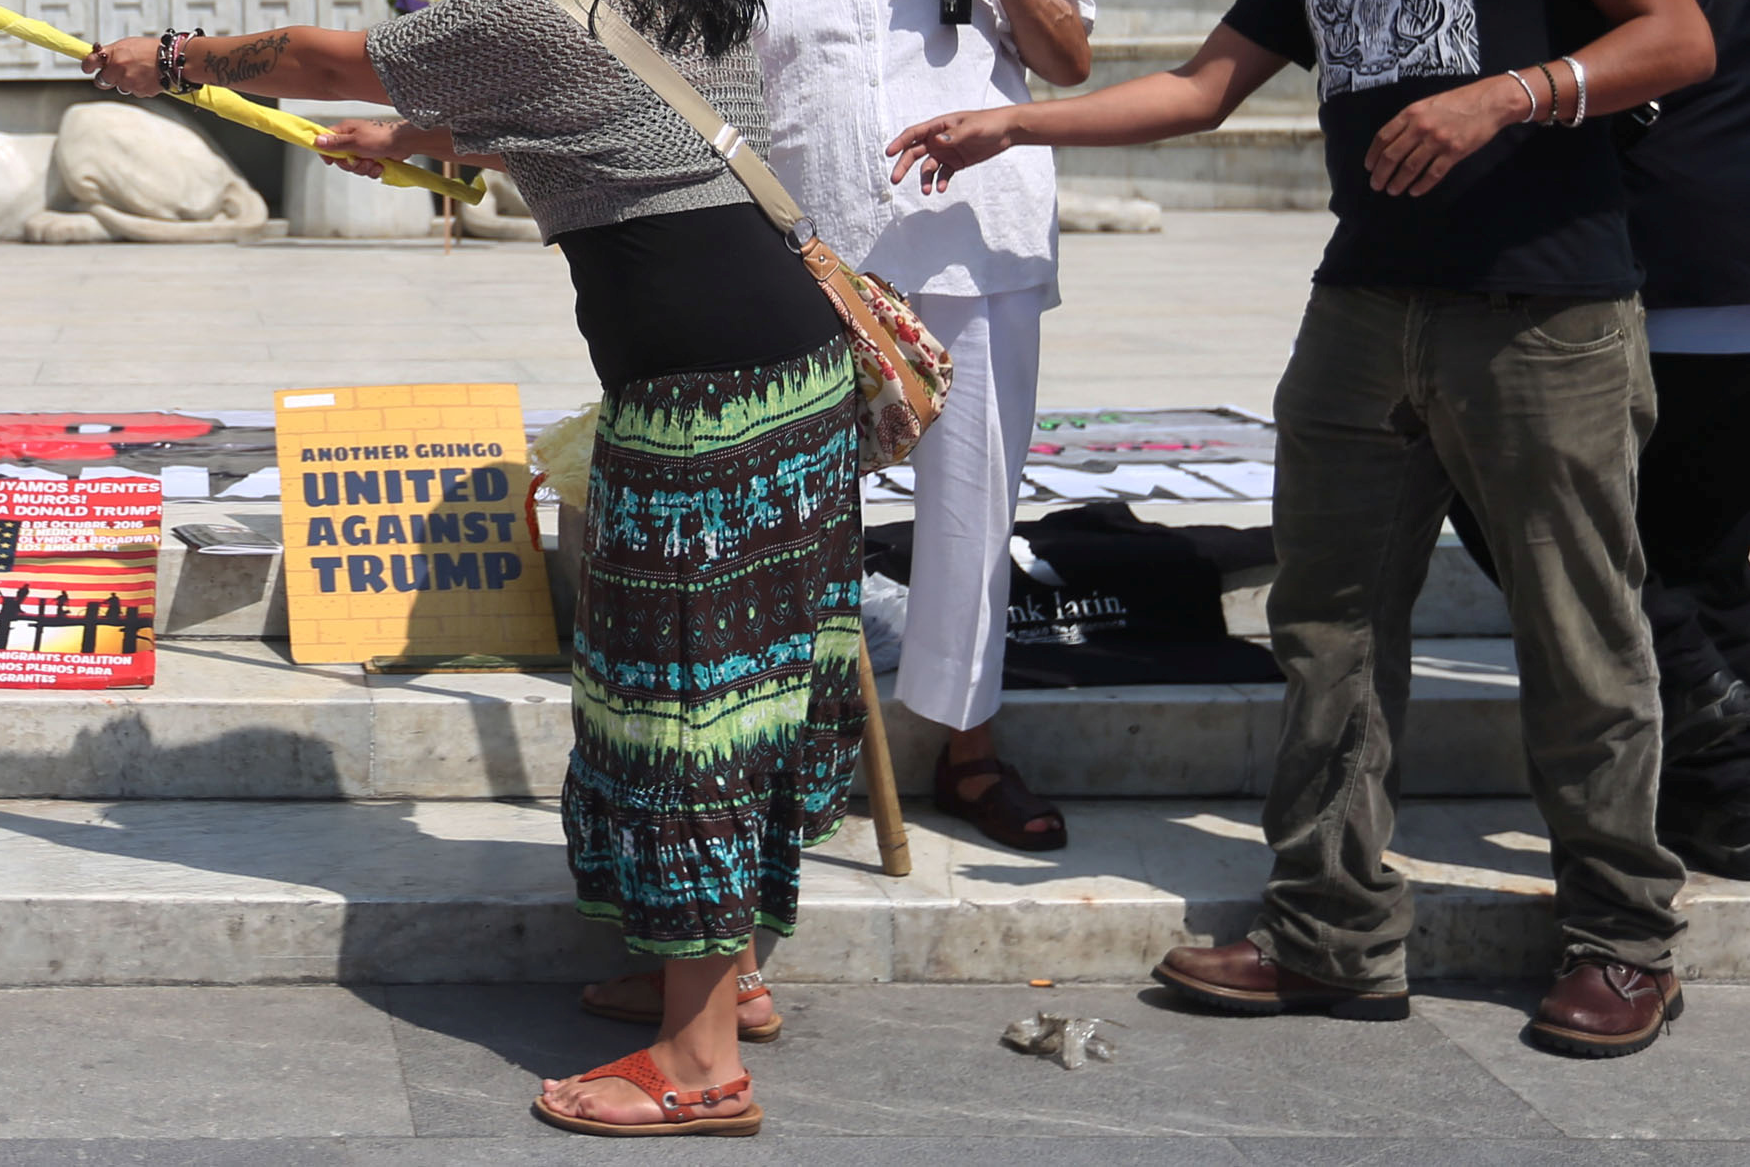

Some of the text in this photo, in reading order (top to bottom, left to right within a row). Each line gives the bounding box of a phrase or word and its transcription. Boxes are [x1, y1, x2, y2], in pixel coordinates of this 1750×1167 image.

[301, 443, 503, 462] ANOTHER GRINGO
[74, 482, 161, 493] PUENTES
[303, 468, 509, 507] UNITED
[12, 493, 87, 505] MUROS!
[14, 505, 89, 517] DONALD
[92, 505, 162, 517] TRUMP!
[21, 520, 144, 530] 8 DE OCTUBRE, 2016
[307, 512, 516, 546] AGAINST
[18, 534, 161, 546] OLYMPIC & BROADWAY
[16, 542, 42, 551] LOS
[311, 552, 522, 593] TRUMP
[63, 655, 132, 665] COALITION
[25, 663, 75, 674] PLENOS
[76, 667, 113, 676] PARA
